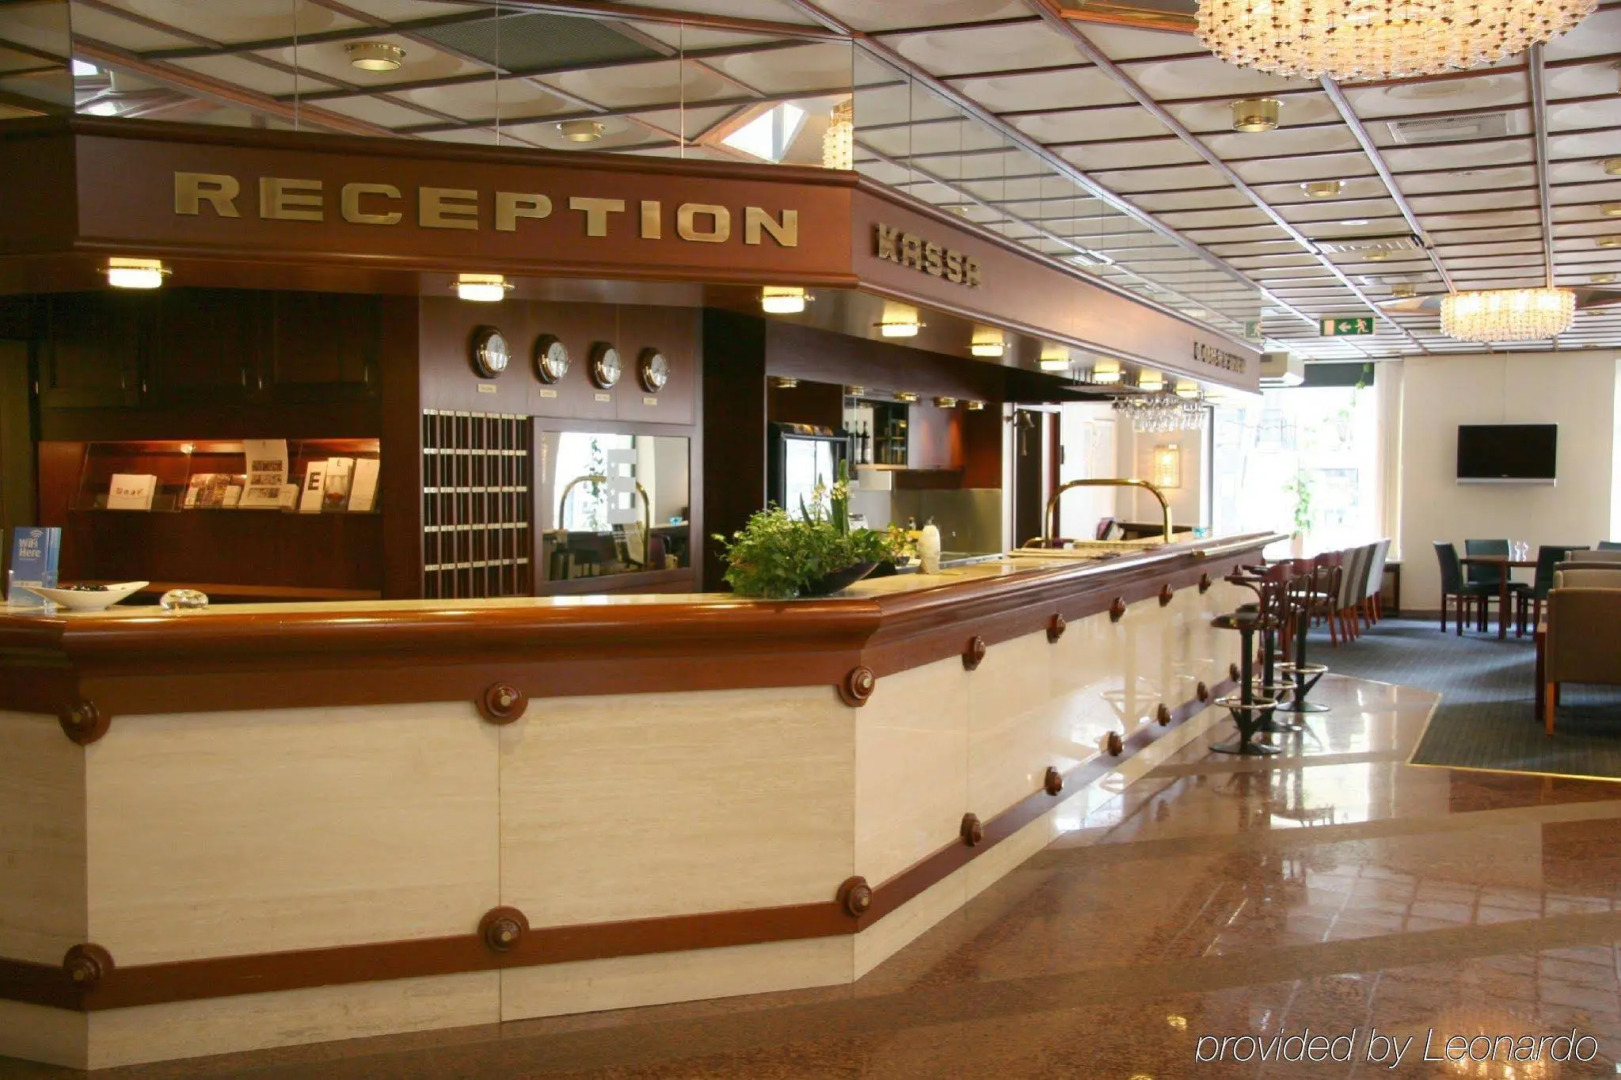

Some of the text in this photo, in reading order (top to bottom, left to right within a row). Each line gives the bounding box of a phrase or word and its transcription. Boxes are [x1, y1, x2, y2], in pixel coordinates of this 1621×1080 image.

[174, 171, 798, 247] RECEPTION
[874, 222, 981, 287] KASSA
[19, 548, 42, 558] Here
